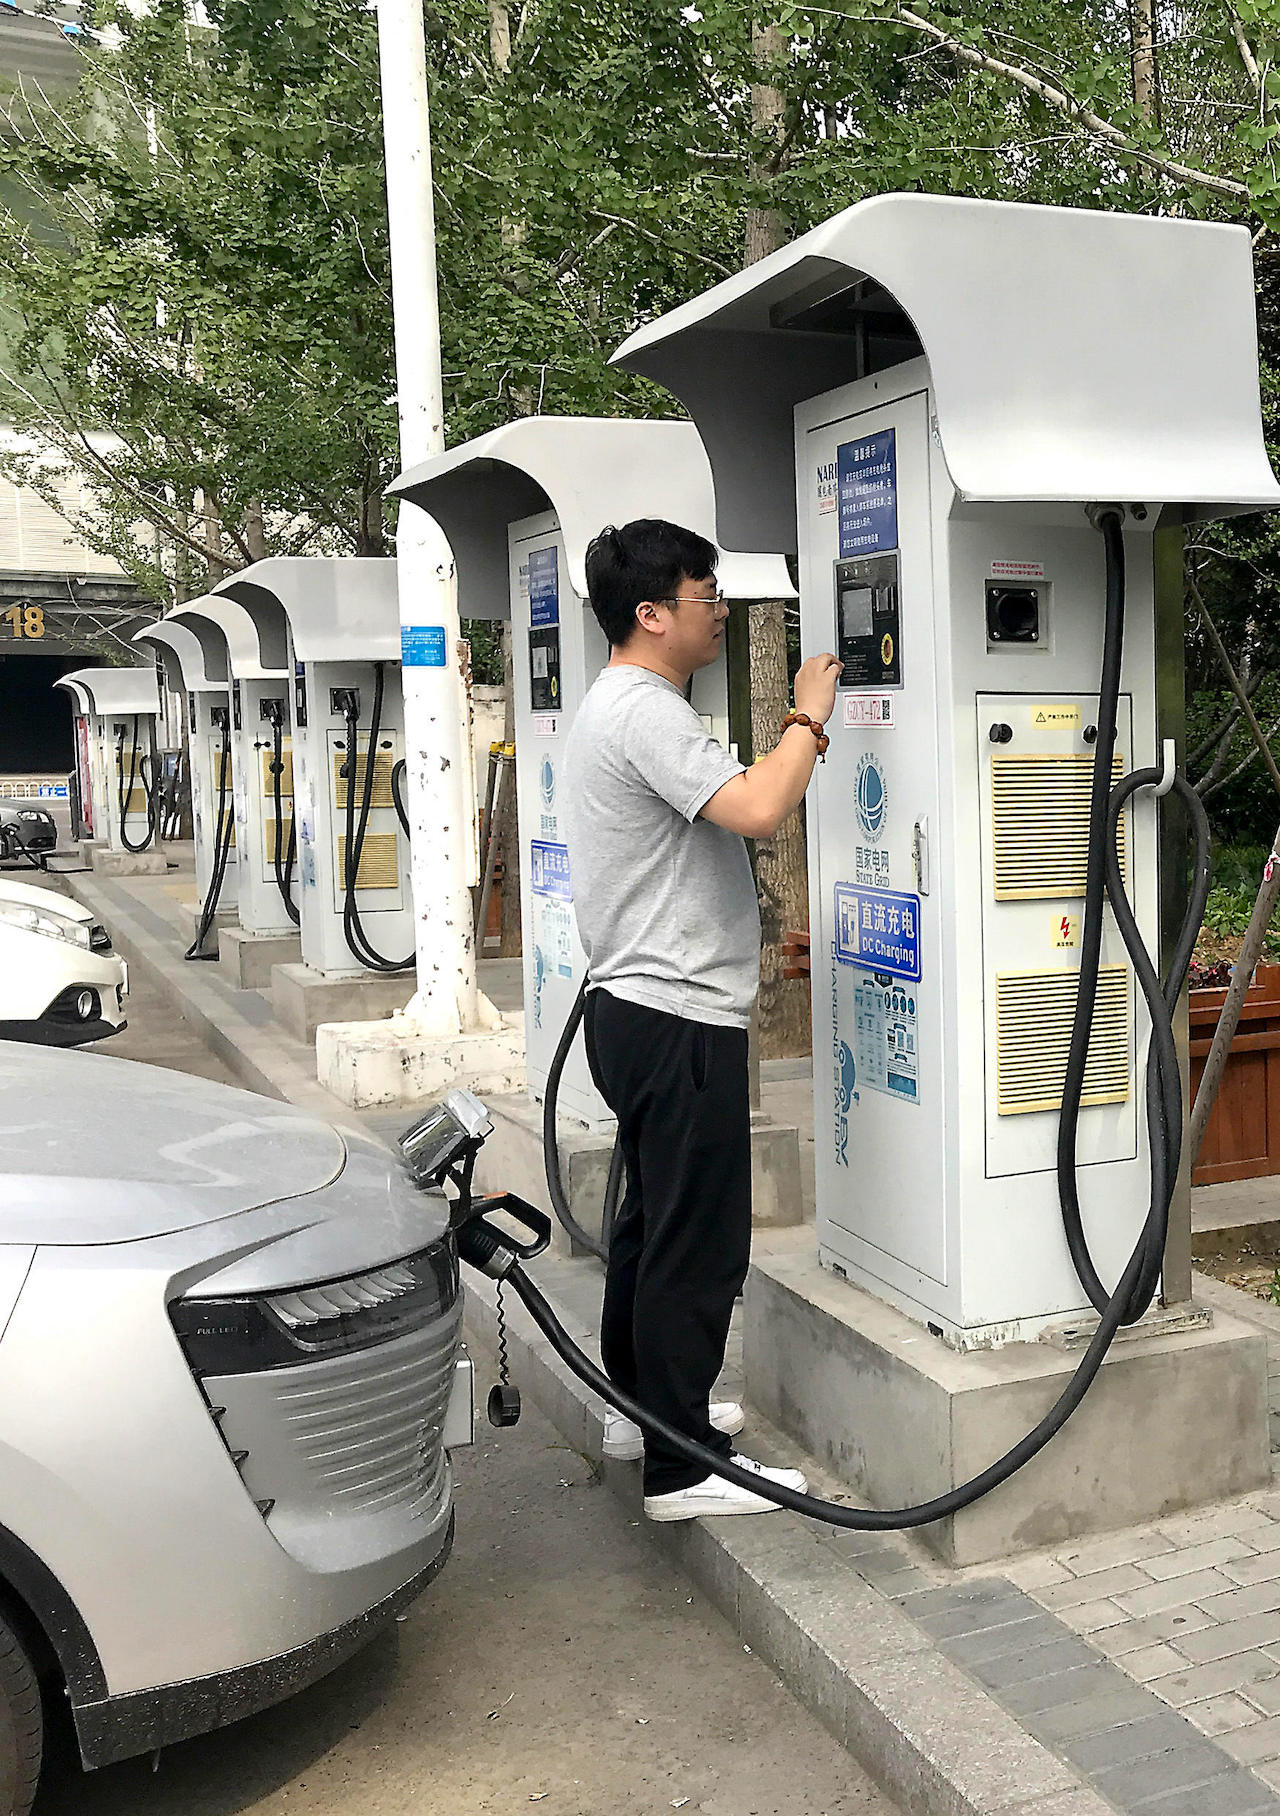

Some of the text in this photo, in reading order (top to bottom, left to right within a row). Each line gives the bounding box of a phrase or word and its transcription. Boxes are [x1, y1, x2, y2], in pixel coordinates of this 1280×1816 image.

[5, 606, 45, 638] 18
[861, 900, 915, 939] 直流充电
[862, 937, 915, 968] DC Charging
